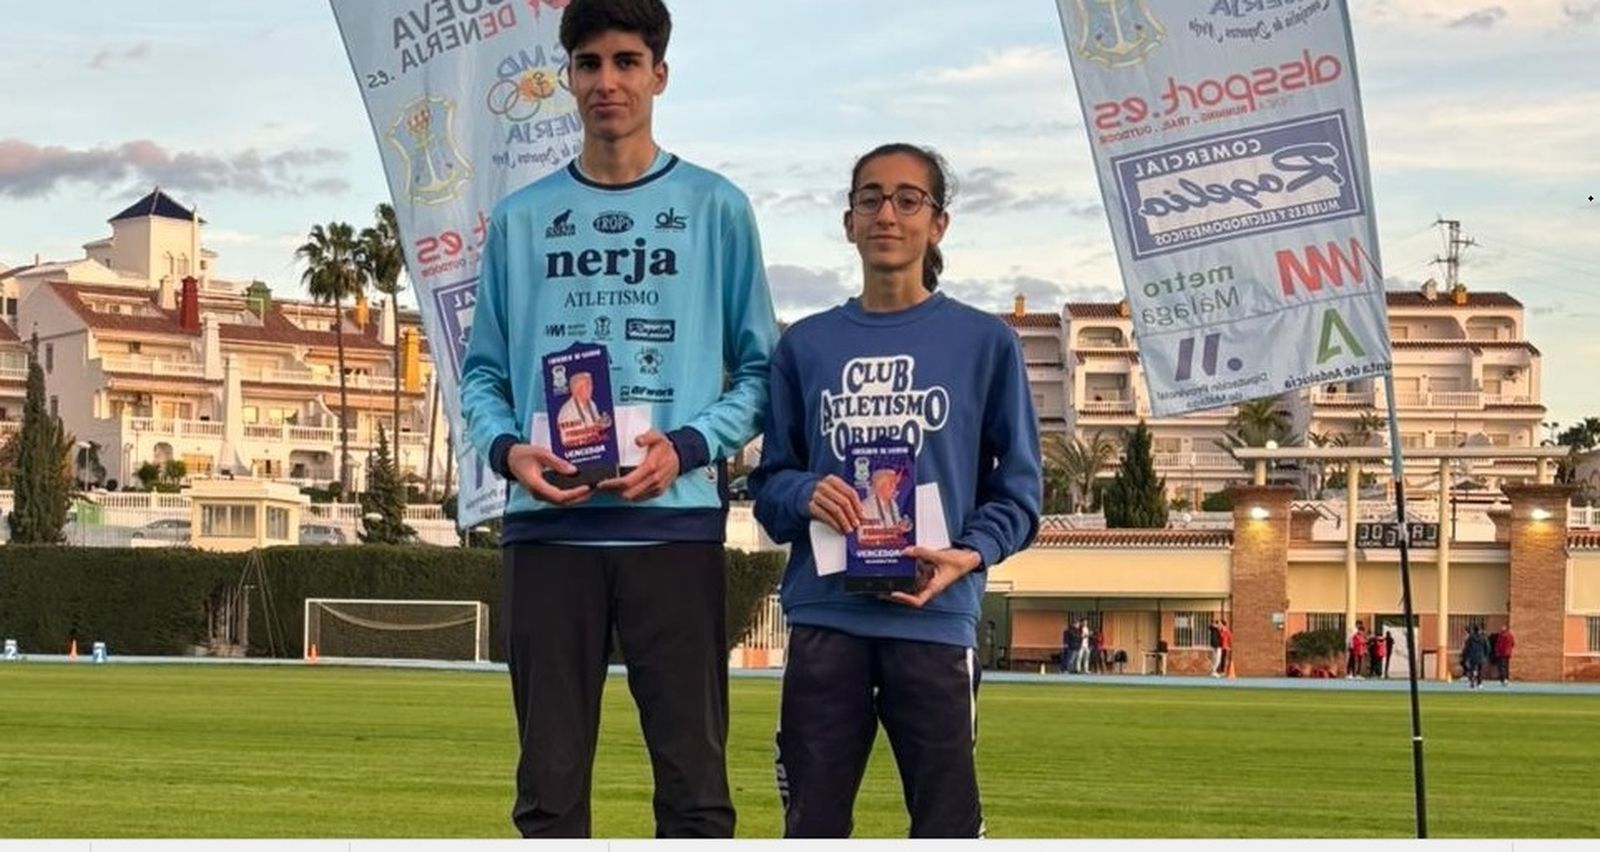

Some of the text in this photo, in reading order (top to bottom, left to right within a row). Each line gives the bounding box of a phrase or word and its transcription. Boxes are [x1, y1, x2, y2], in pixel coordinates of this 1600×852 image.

[546, 237, 678, 285] nerja
[564, 289, 660, 309] ATLETISMO
[846, 358, 909, 394] CLUB
[822, 389, 948, 433] ATLETISMO
